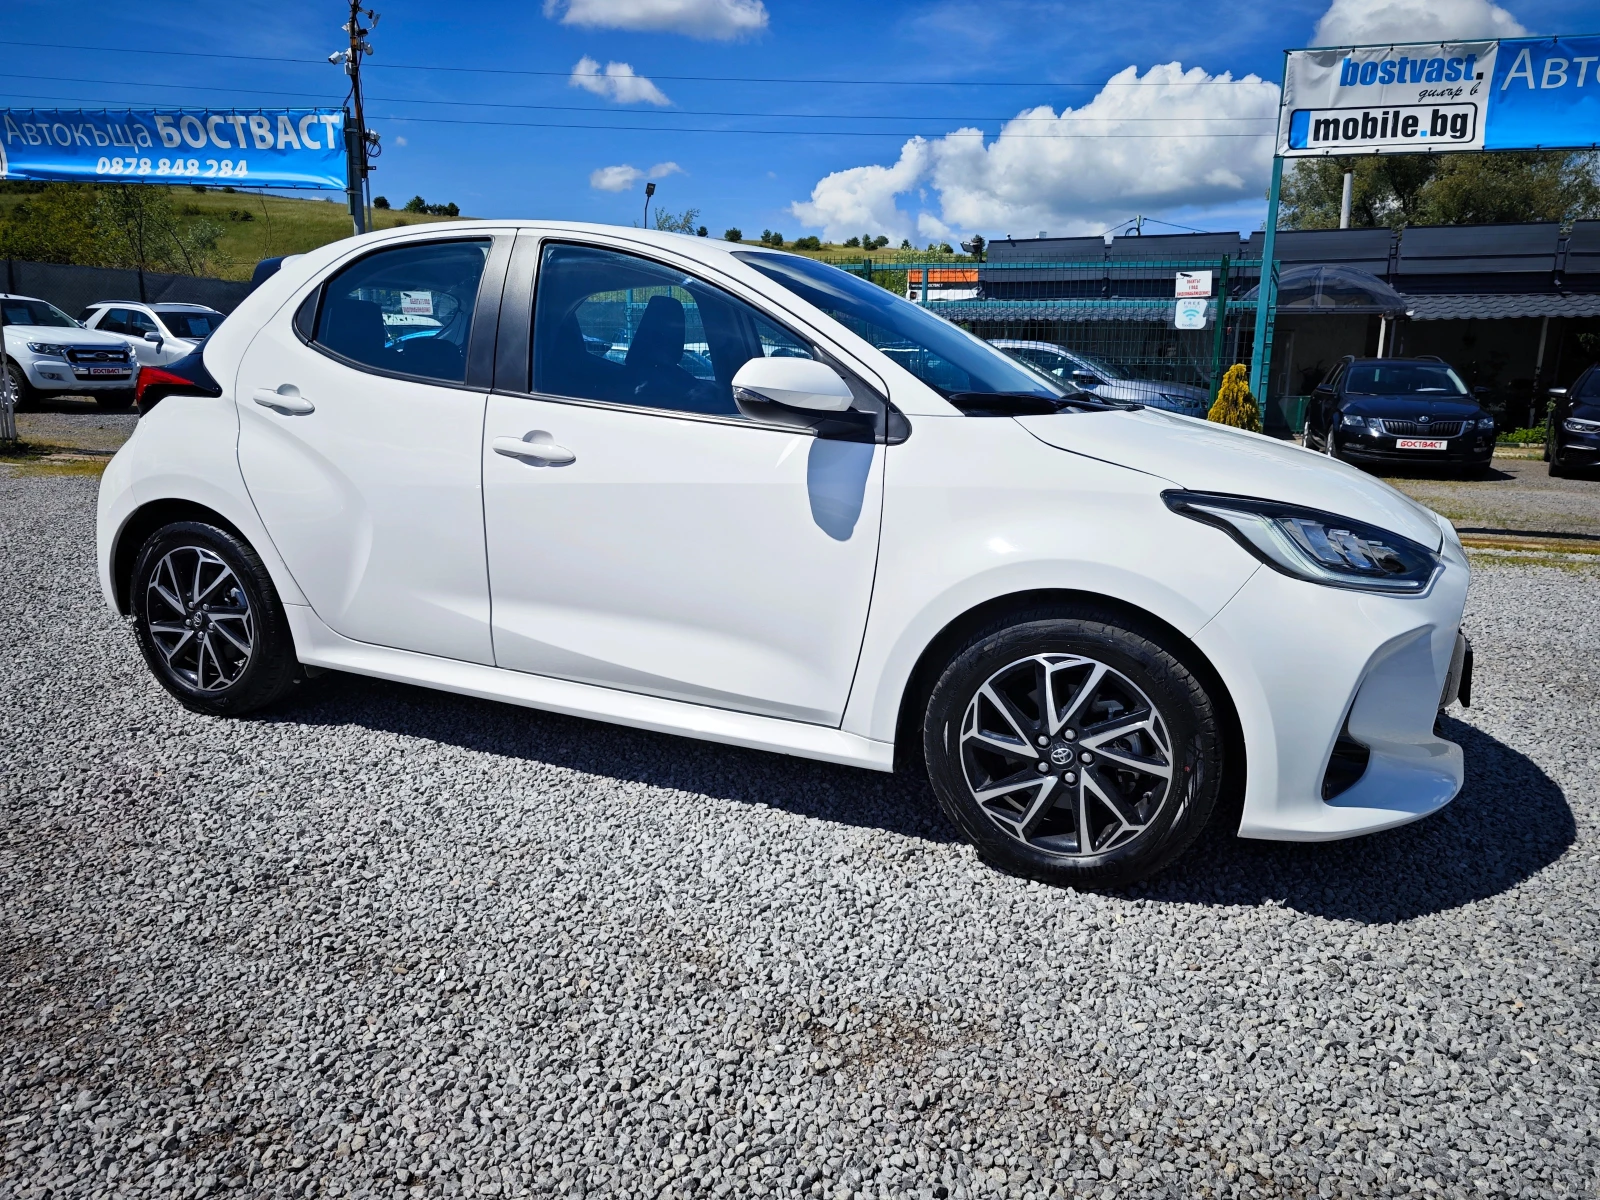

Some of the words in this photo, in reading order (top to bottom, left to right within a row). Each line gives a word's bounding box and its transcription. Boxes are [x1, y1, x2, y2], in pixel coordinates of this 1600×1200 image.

[1501, 48, 1600, 91] Авт
[3, 114, 152, 153] Автокъща
[154, 115, 339, 149] БОСТВАСТ
[1313, 109, 1468, 141] mobile.bg
[96, 156, 151, 175] 0878
[158, 157, 199, 176] 848
[204, 160, 248, 177] 284
